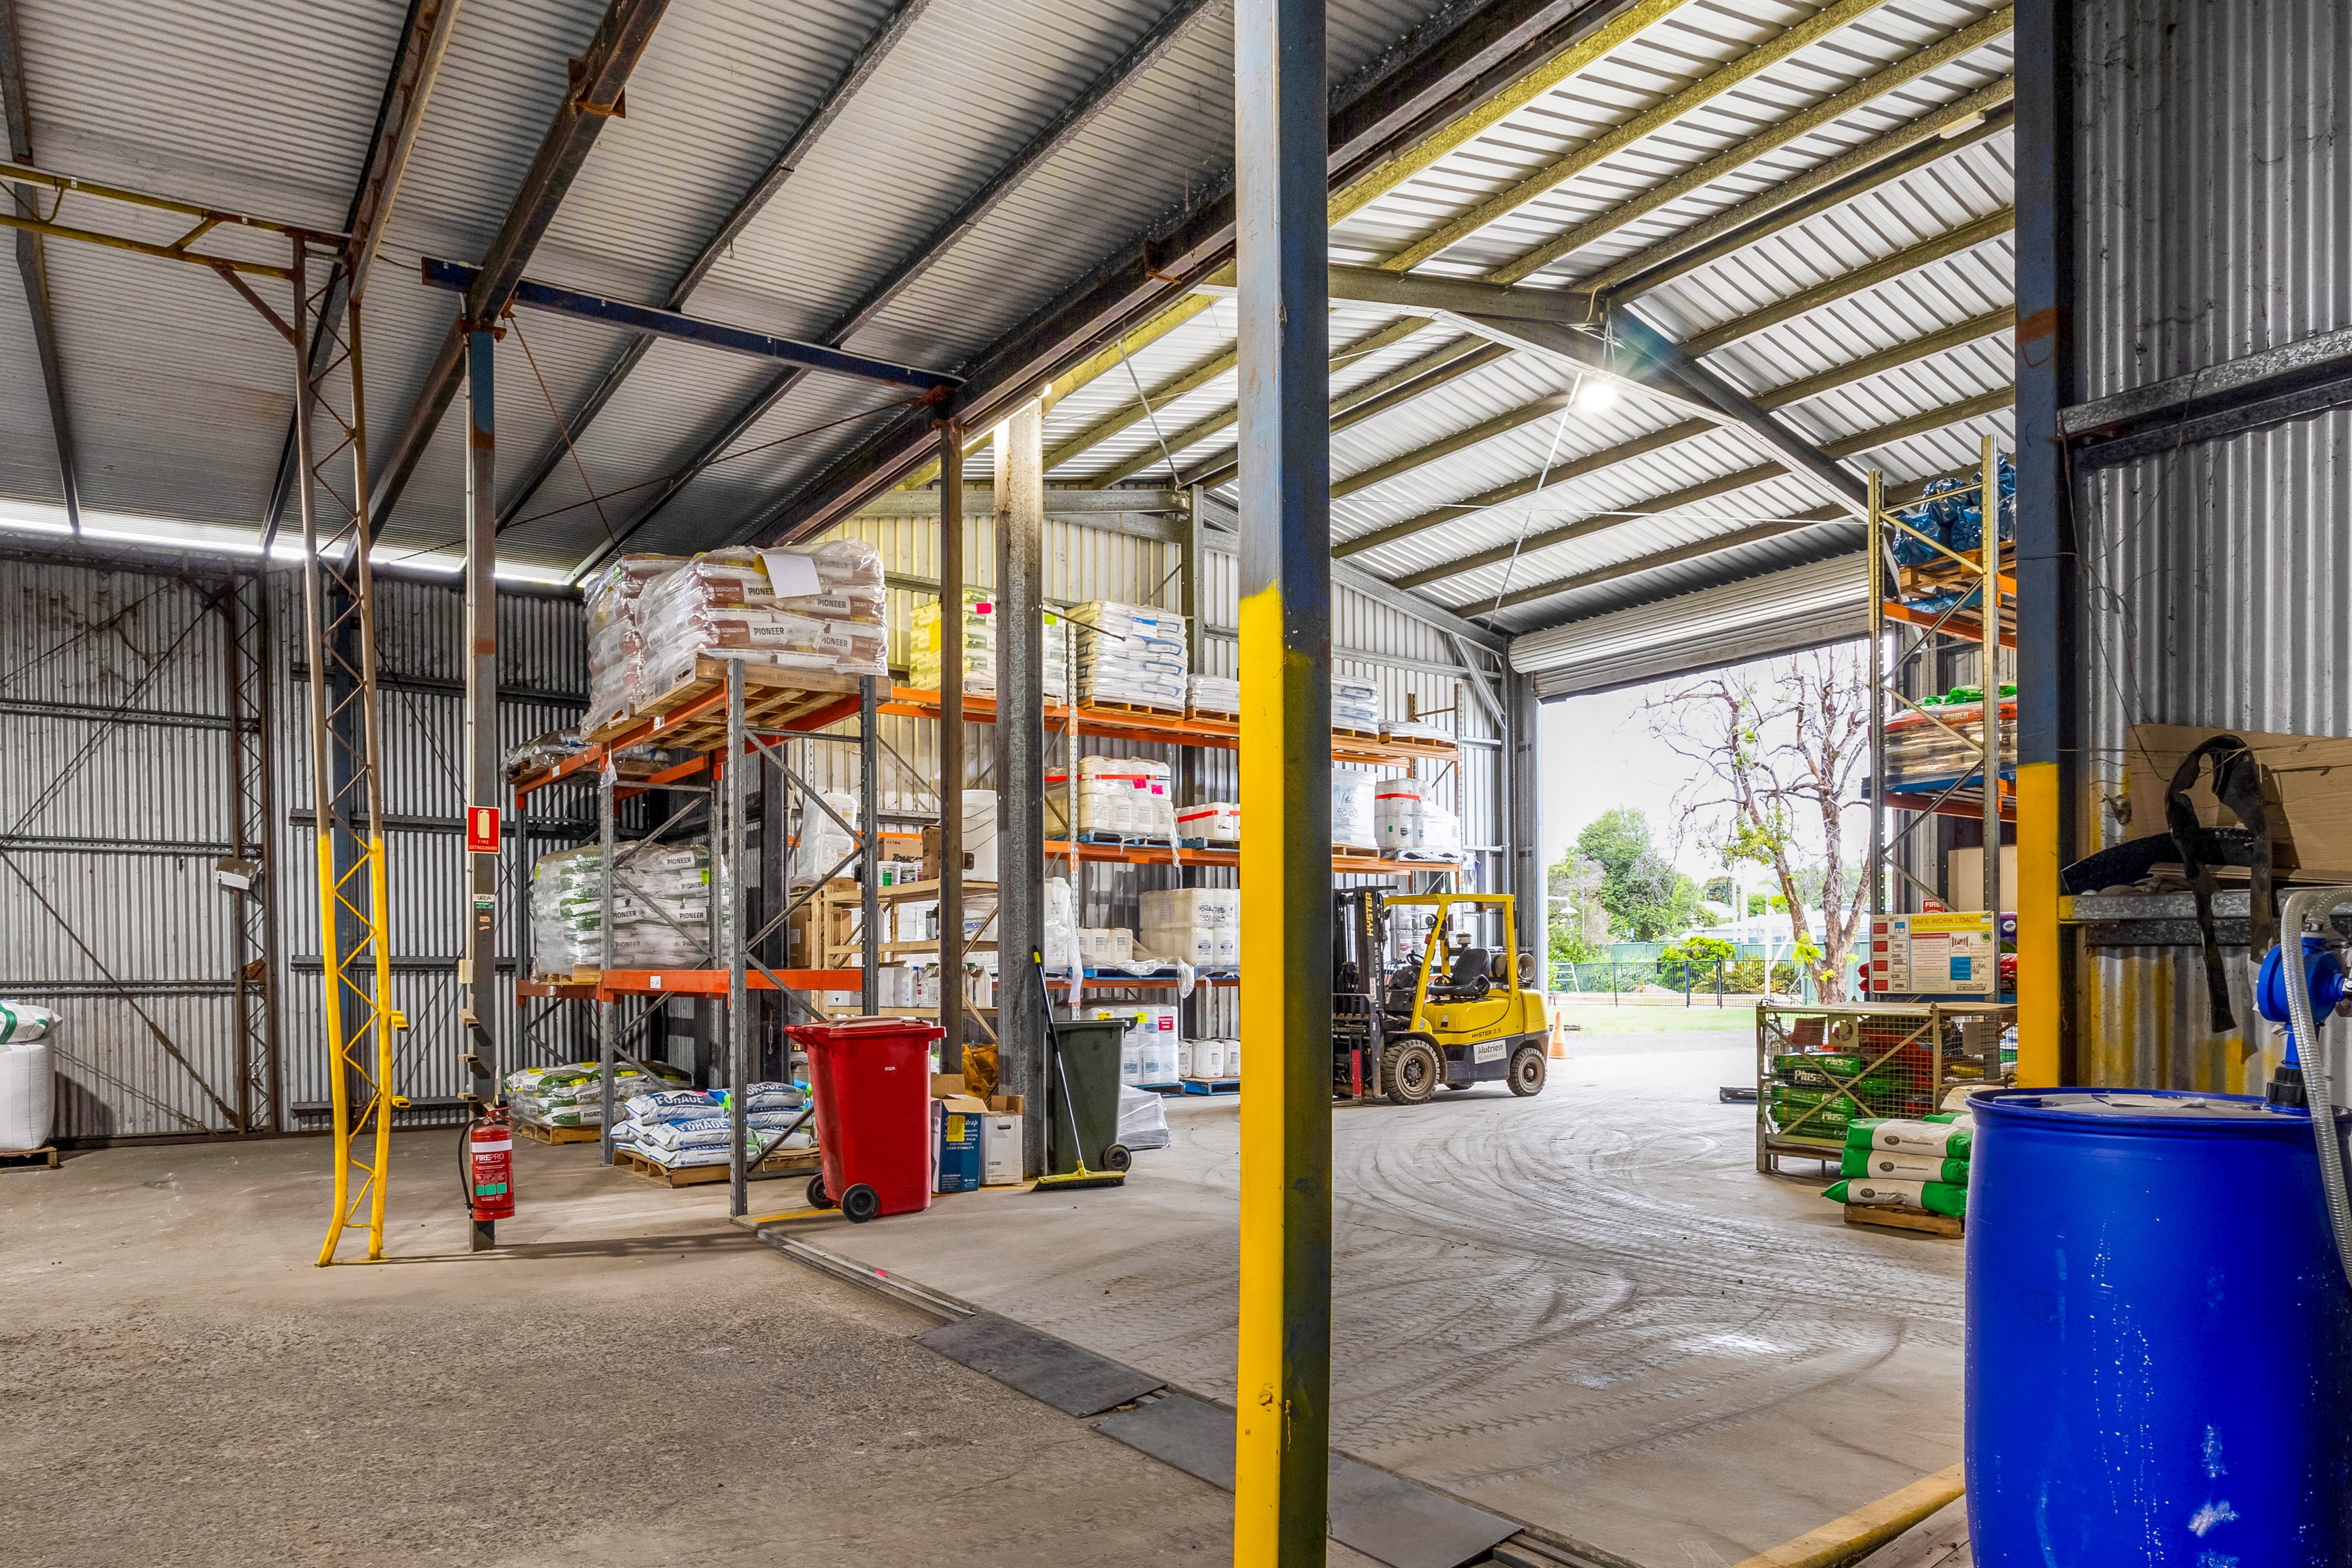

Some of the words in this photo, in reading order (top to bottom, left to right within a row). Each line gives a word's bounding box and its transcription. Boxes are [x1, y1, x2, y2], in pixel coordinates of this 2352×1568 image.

[818, 598, 846, 609] PIONEER
[753, 627, 784, 635] PIONEER
[777, 674, 803, 683] Brand
[613, 910, 637, 918] PIONEER
[1365, 892, 1374, 937] HYSTER
[1472, 1030, 1492, 1039] HYSTER
[1478, 1043, 1503, 1054] Nutrien
[1795, 1070, 1816, 1081] Plus
[1822, 1111, 1840, 1120] Plus
[677, 1120, 728, 1131] FORAGE
[475, 1153, 504, 1161] FIREPRO
